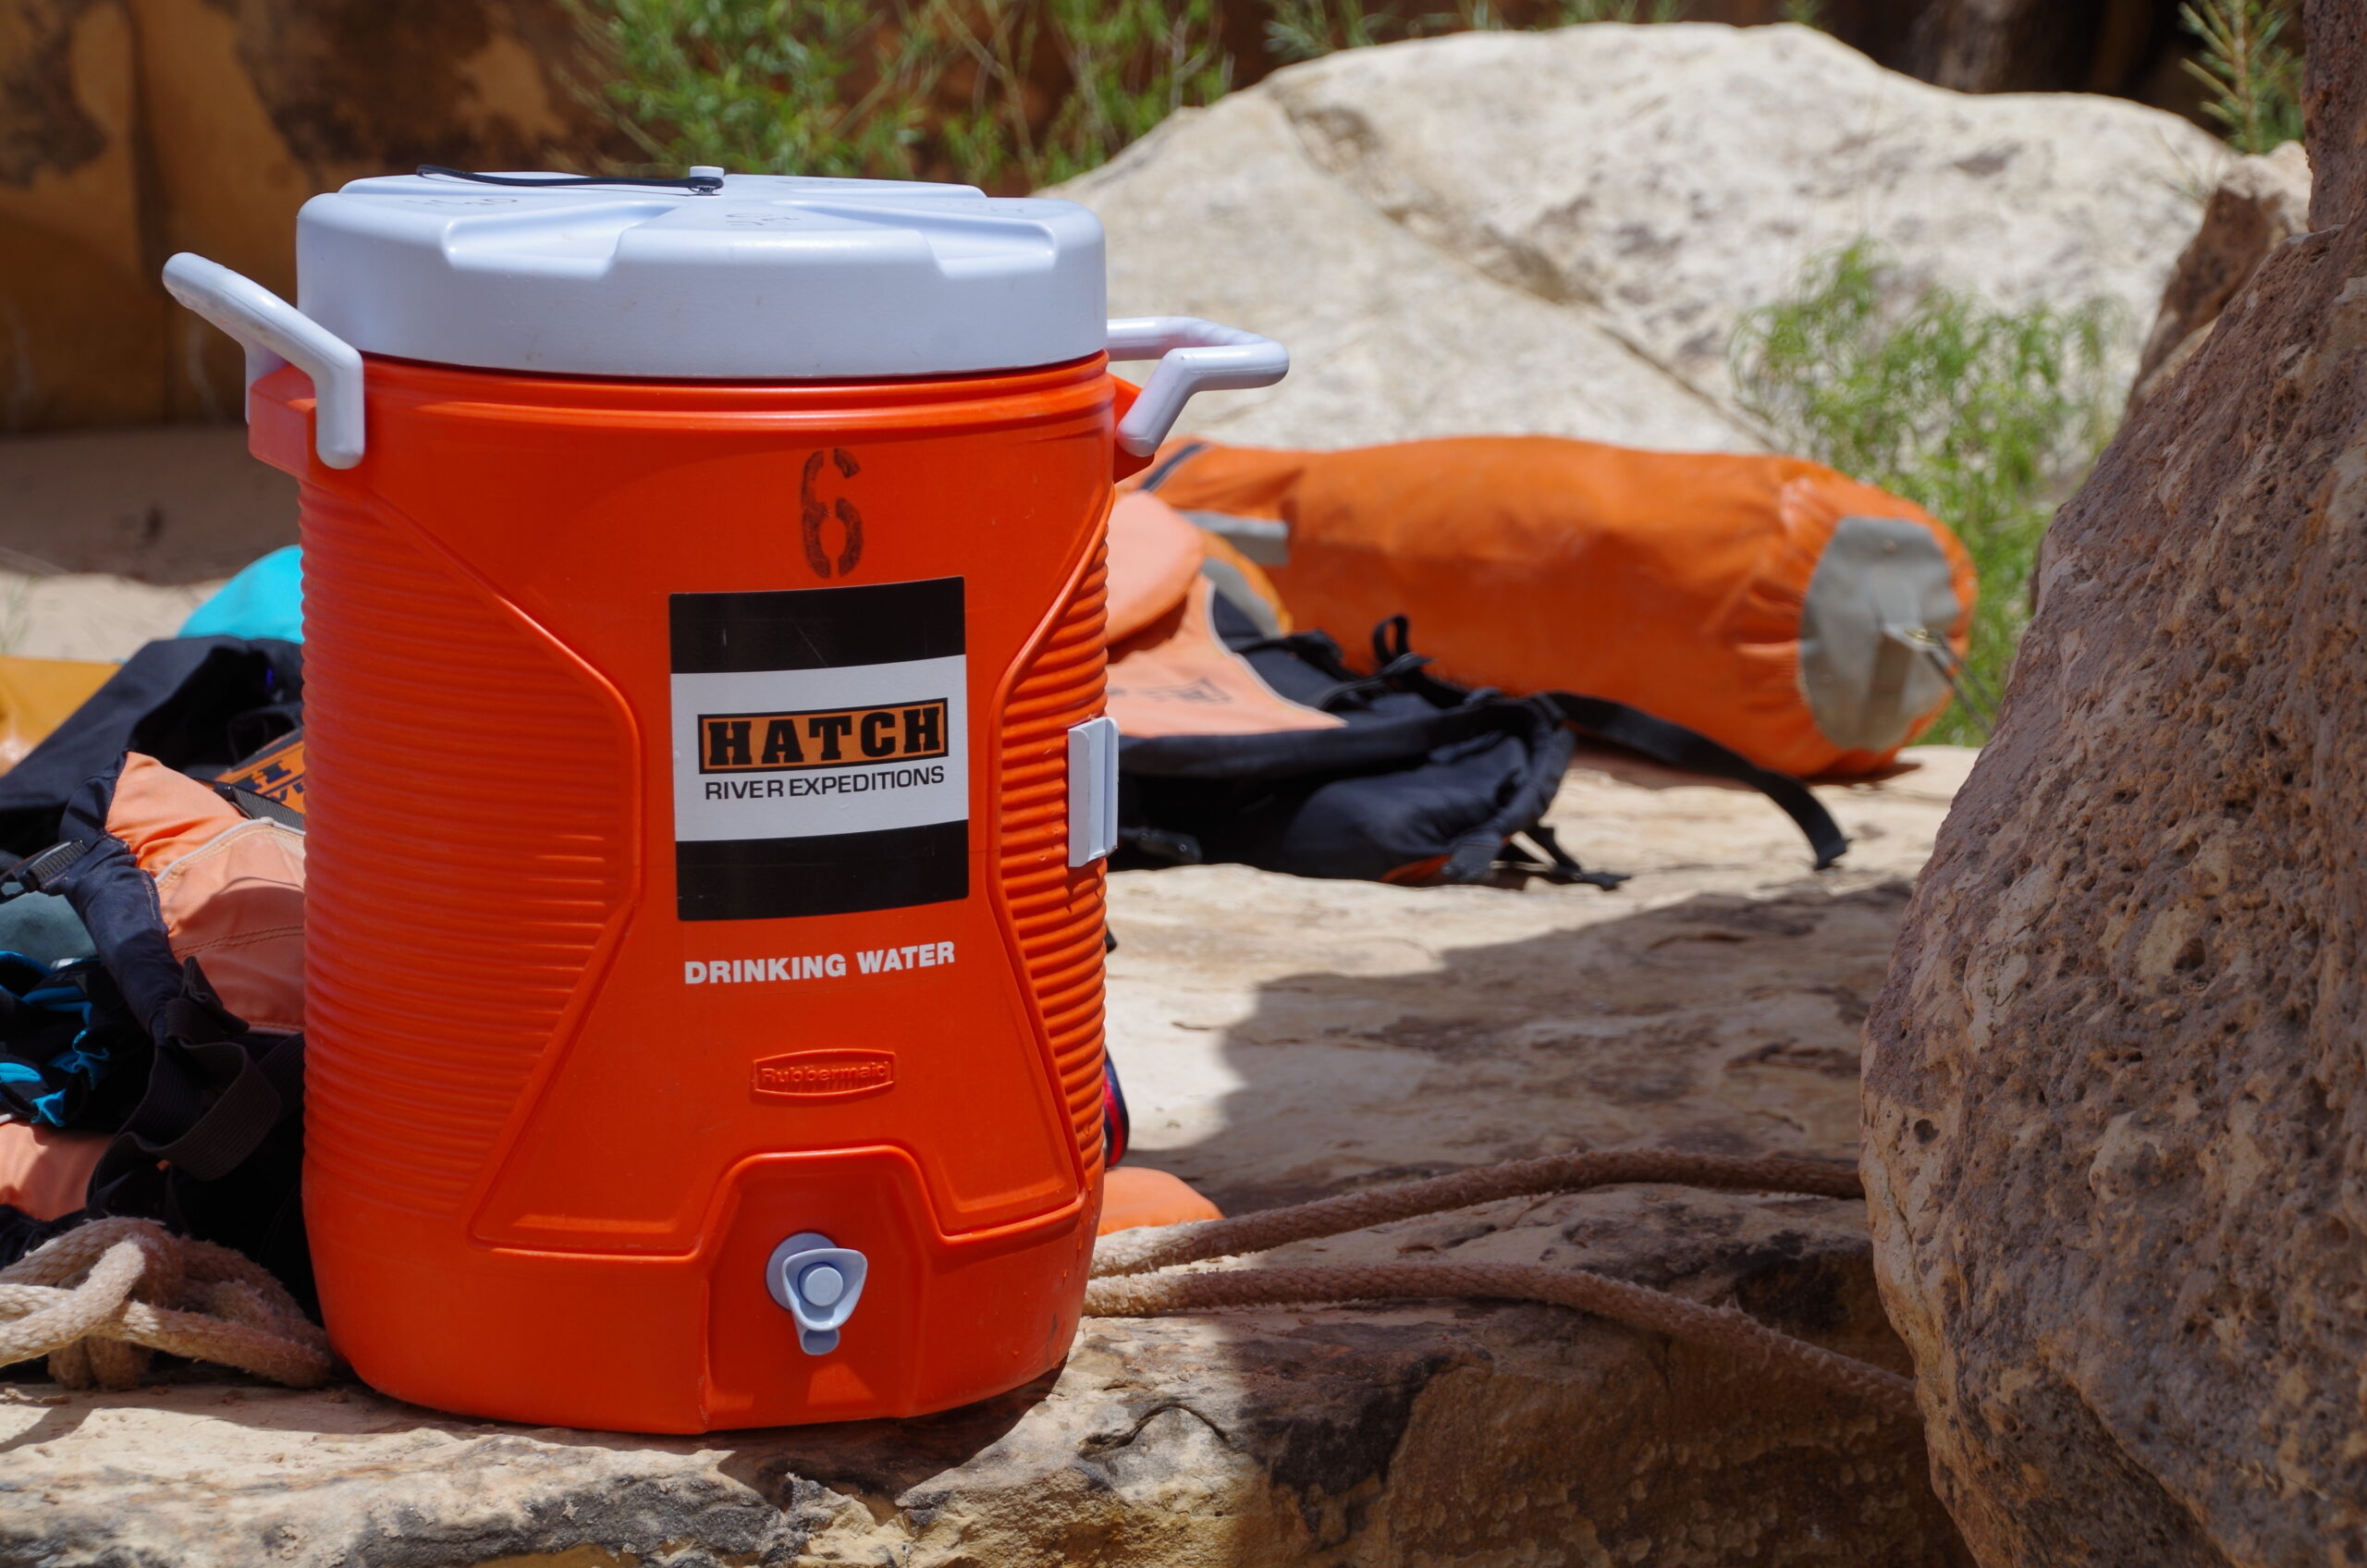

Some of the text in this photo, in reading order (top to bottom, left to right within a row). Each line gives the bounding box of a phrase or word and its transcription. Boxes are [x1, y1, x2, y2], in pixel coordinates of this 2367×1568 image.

[801, 447, 864, 579] 6
[708, 706, 940, 766] HATCH
[705, 766, 945, 800] RIVER EXPEDITIONS
[684, 941, 955, 985] DRINKING WATER
[761, 1060, 889, 1084] Rubbermaid
